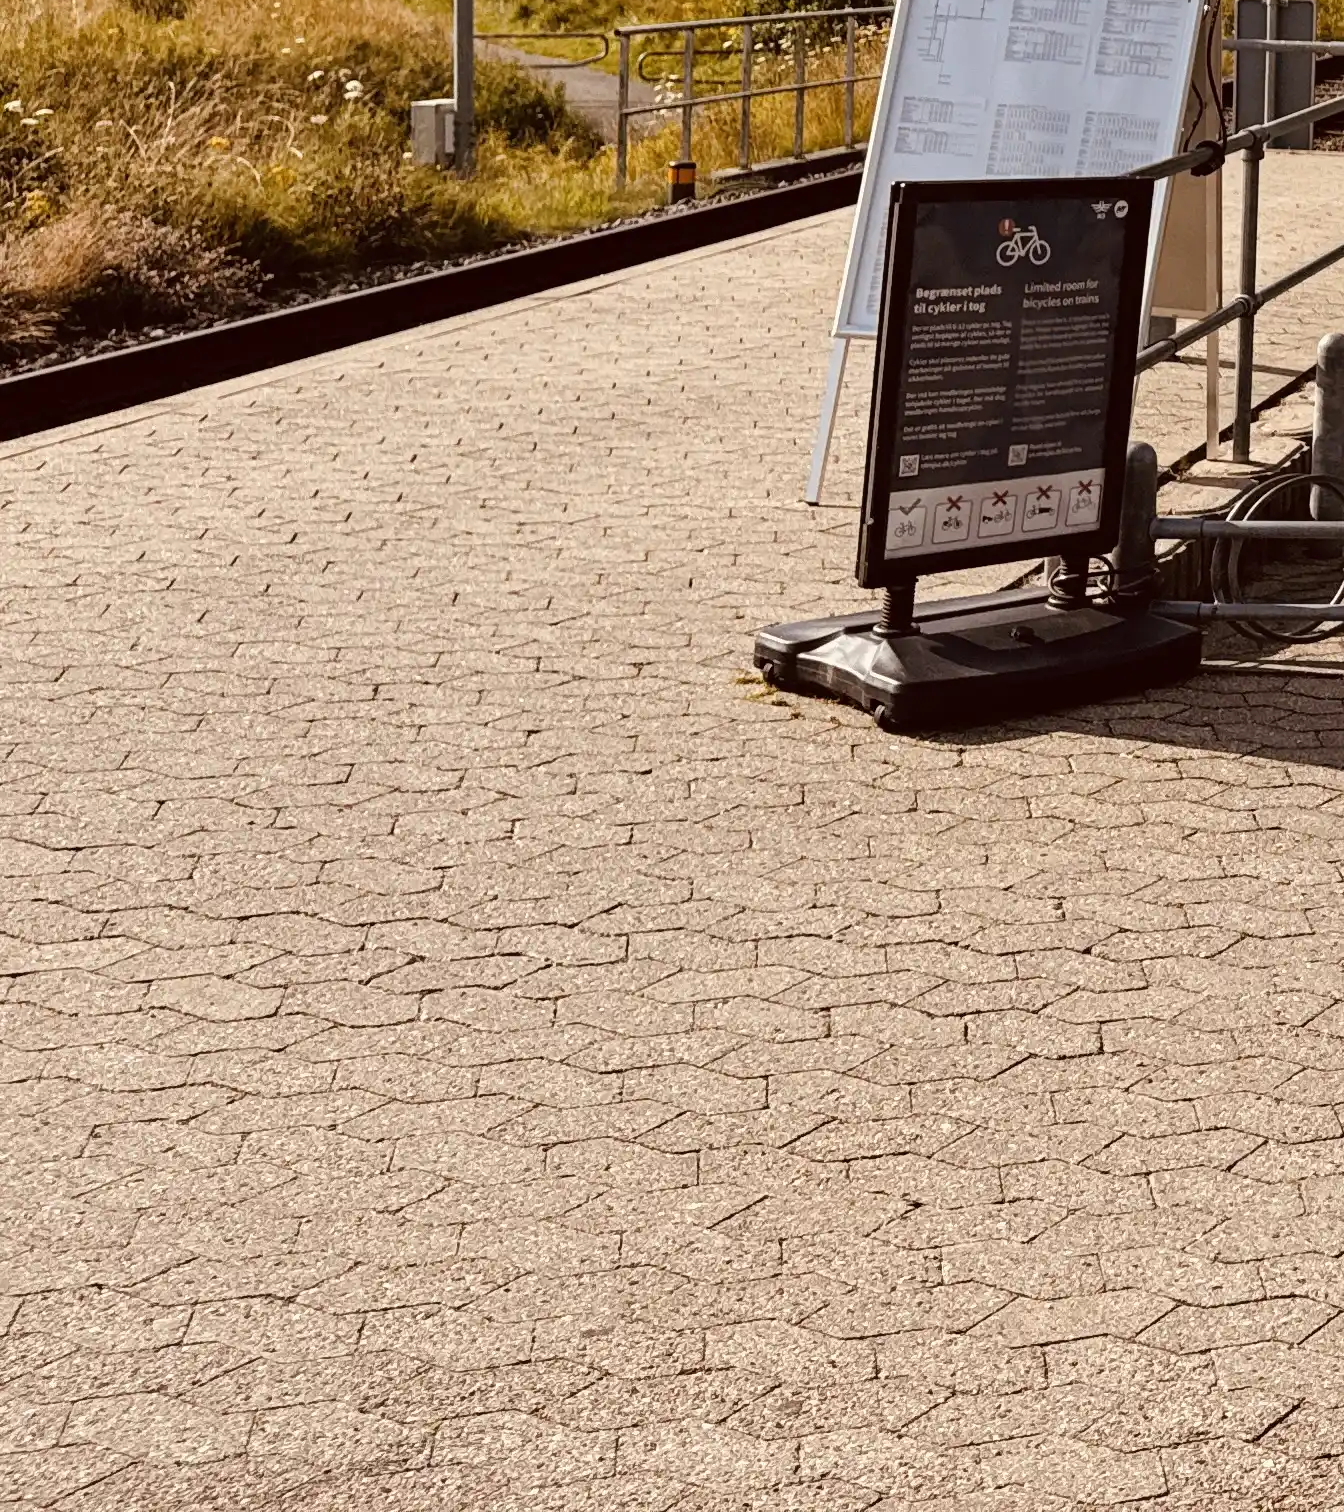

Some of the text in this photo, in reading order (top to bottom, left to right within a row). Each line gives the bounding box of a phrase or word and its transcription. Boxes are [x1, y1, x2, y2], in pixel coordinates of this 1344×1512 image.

[915, 284, 1002, 301] Begrænset plads
[1024, 279, 1099, 294] Limited room for
[914, 301, 986, 316] til cykler i tog
[1022, 293, 1100, 310] bicycles on trains
